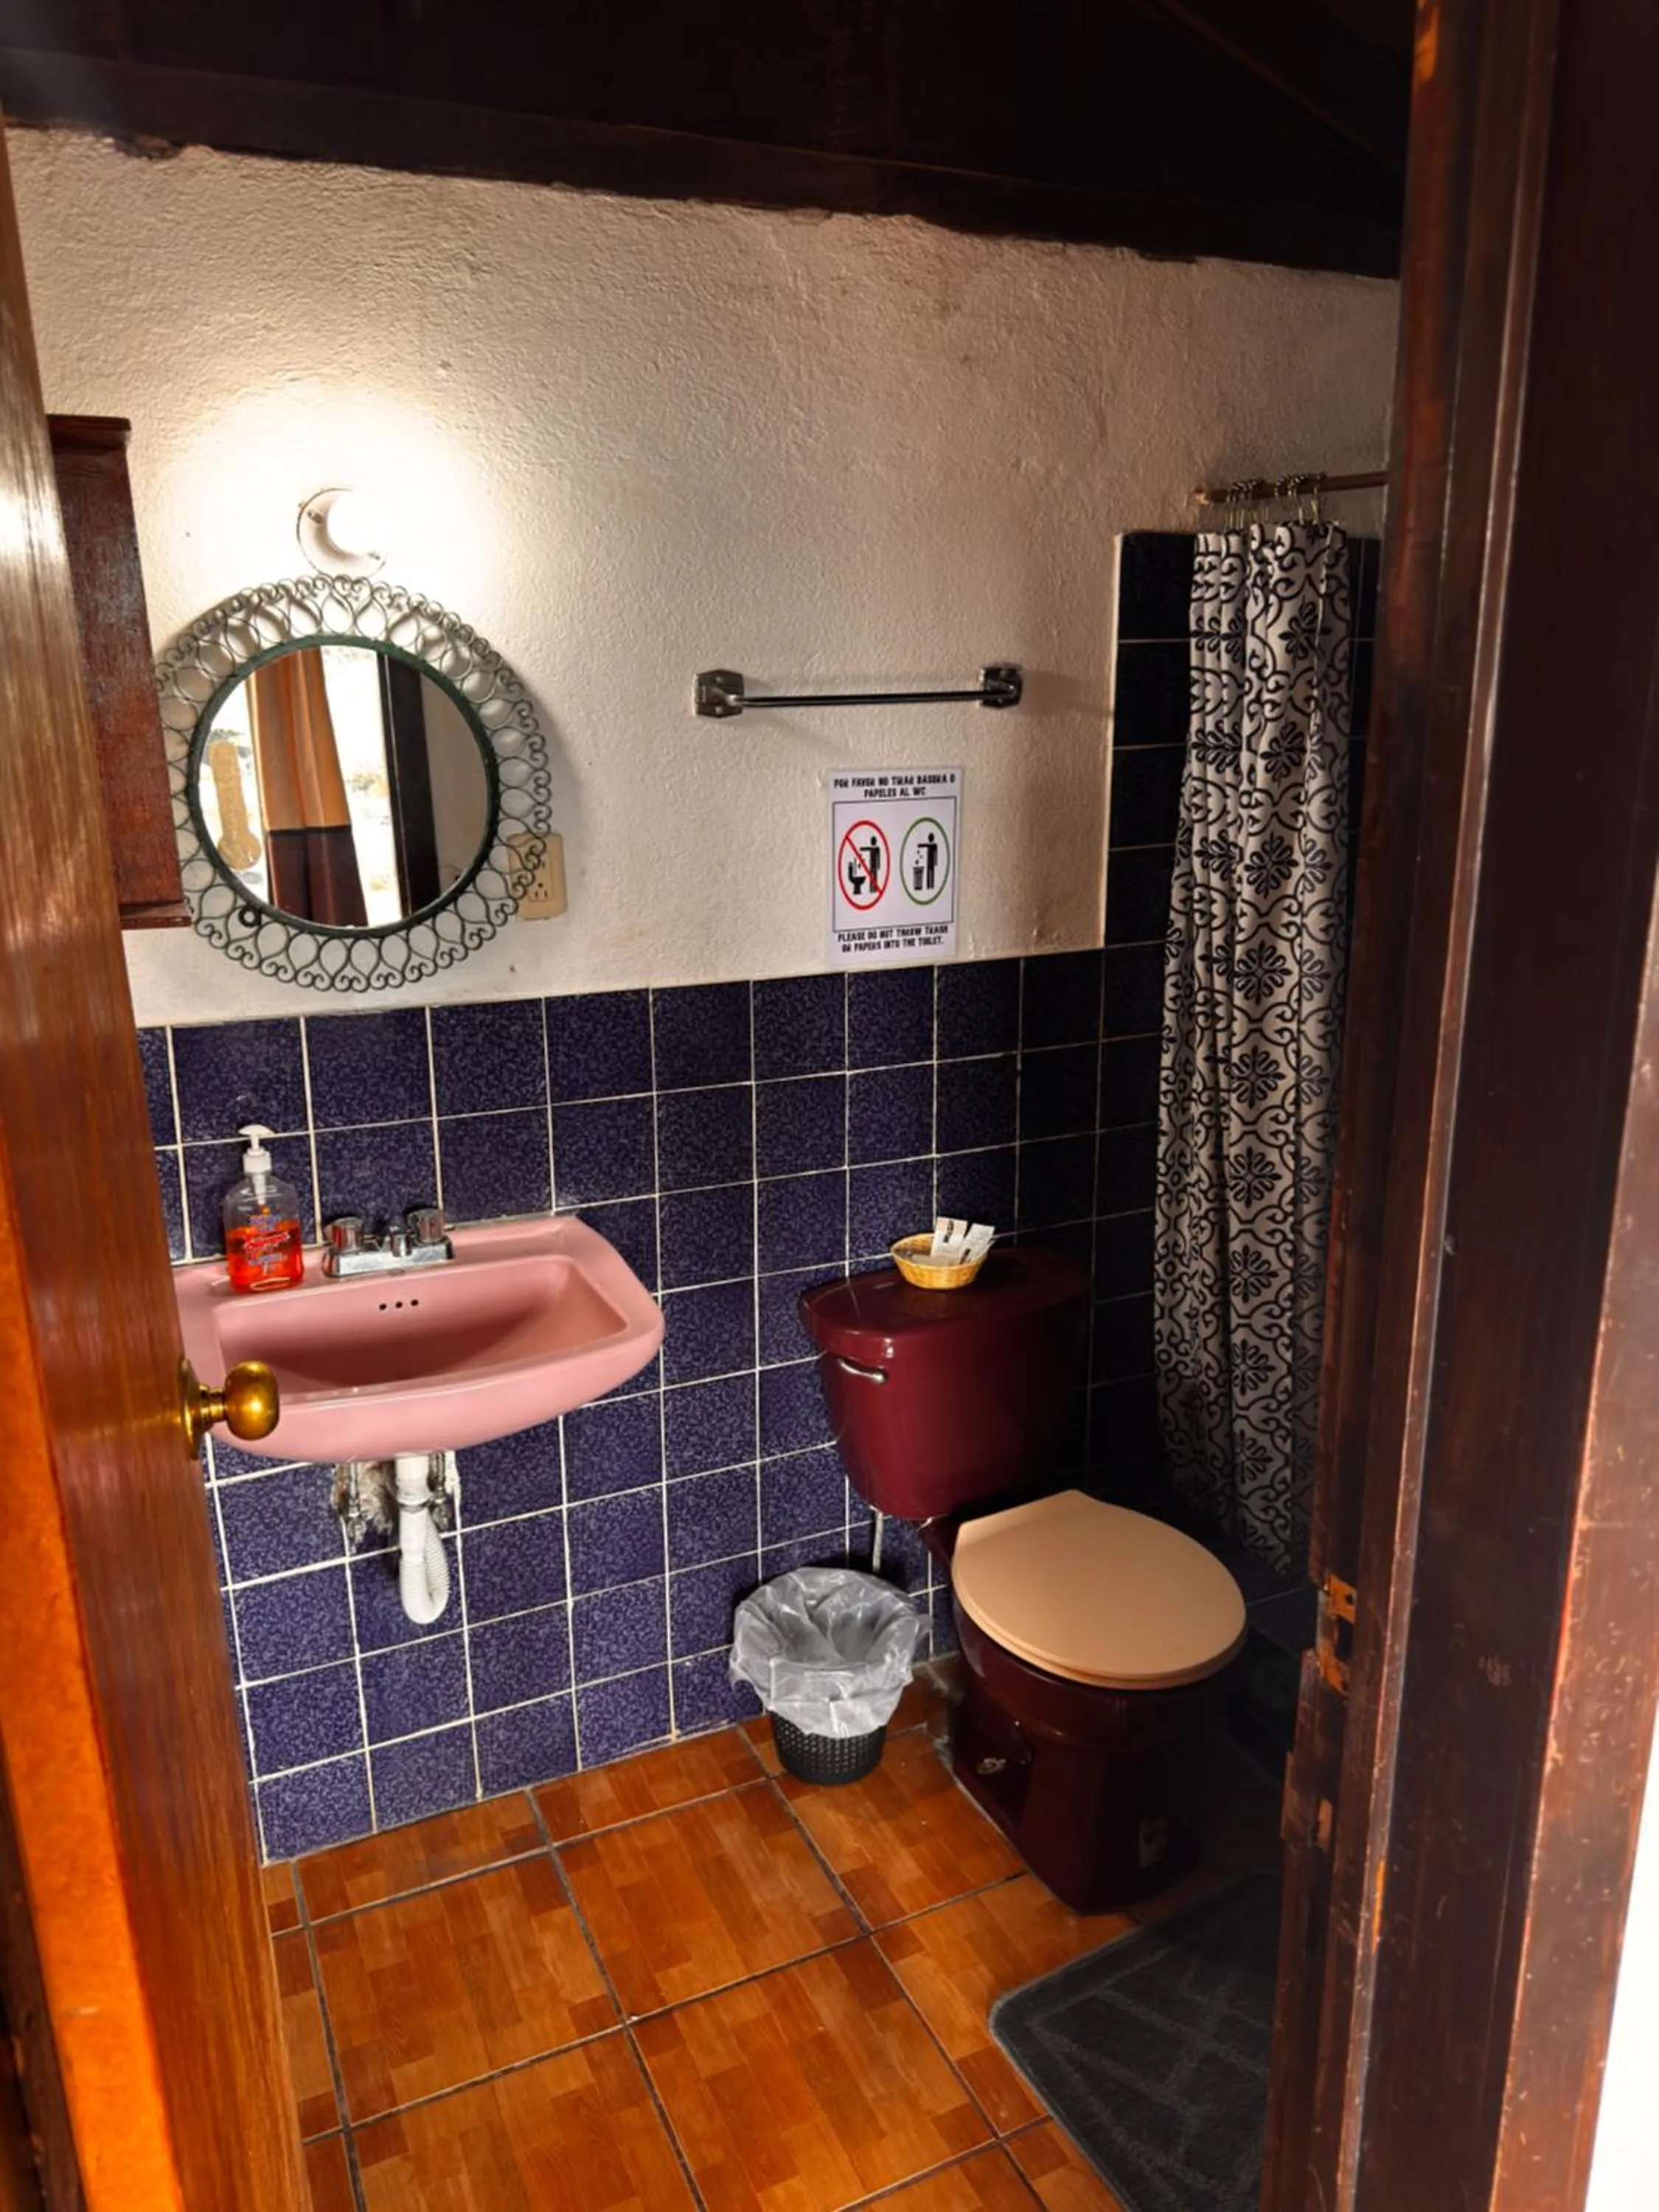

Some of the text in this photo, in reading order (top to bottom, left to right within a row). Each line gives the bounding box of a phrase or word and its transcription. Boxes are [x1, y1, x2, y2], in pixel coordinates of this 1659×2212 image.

[834, 779, 849, 788] POR
[852, 777, 875, 787] FAVOR
[878, 776, 888, 786] NO
[863, 787, 926, 798] PAPELES AL WC
[838, 932, 865, 942] PLEASE
[867, 931, 877, 939] DO
[880, 930, 893, 939] NOT
[842, 944, 852, 953] OR
[854, 942, 881, 952] PAPERS
[883, 940, 900, 949] INTO
[903, 939, 916, 947] THE
